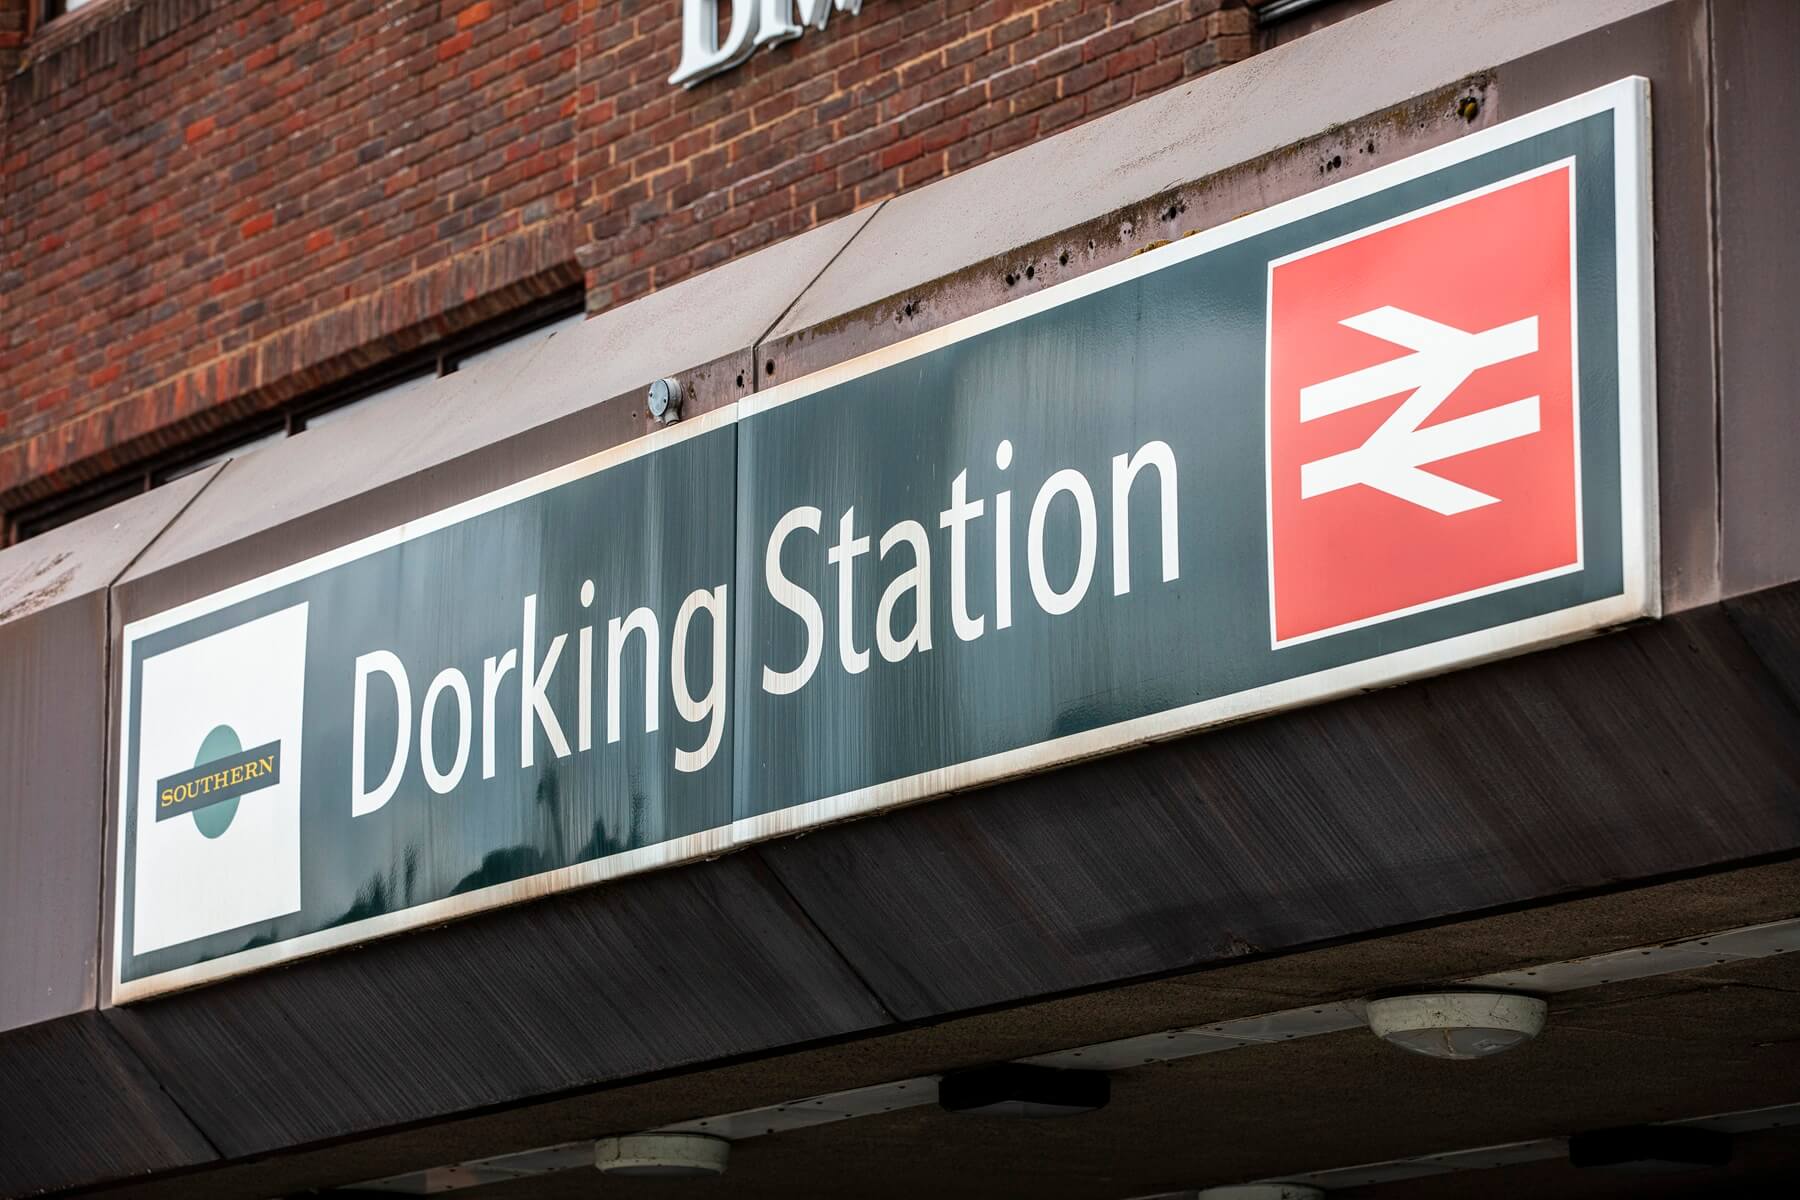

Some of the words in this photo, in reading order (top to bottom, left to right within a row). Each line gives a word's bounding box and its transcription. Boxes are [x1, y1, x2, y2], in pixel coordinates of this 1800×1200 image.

[351, 579, 728, 818] Dorking
[761, 439, 1180, 695] Station
[160, 755, 275, 808] SOUTHERN
